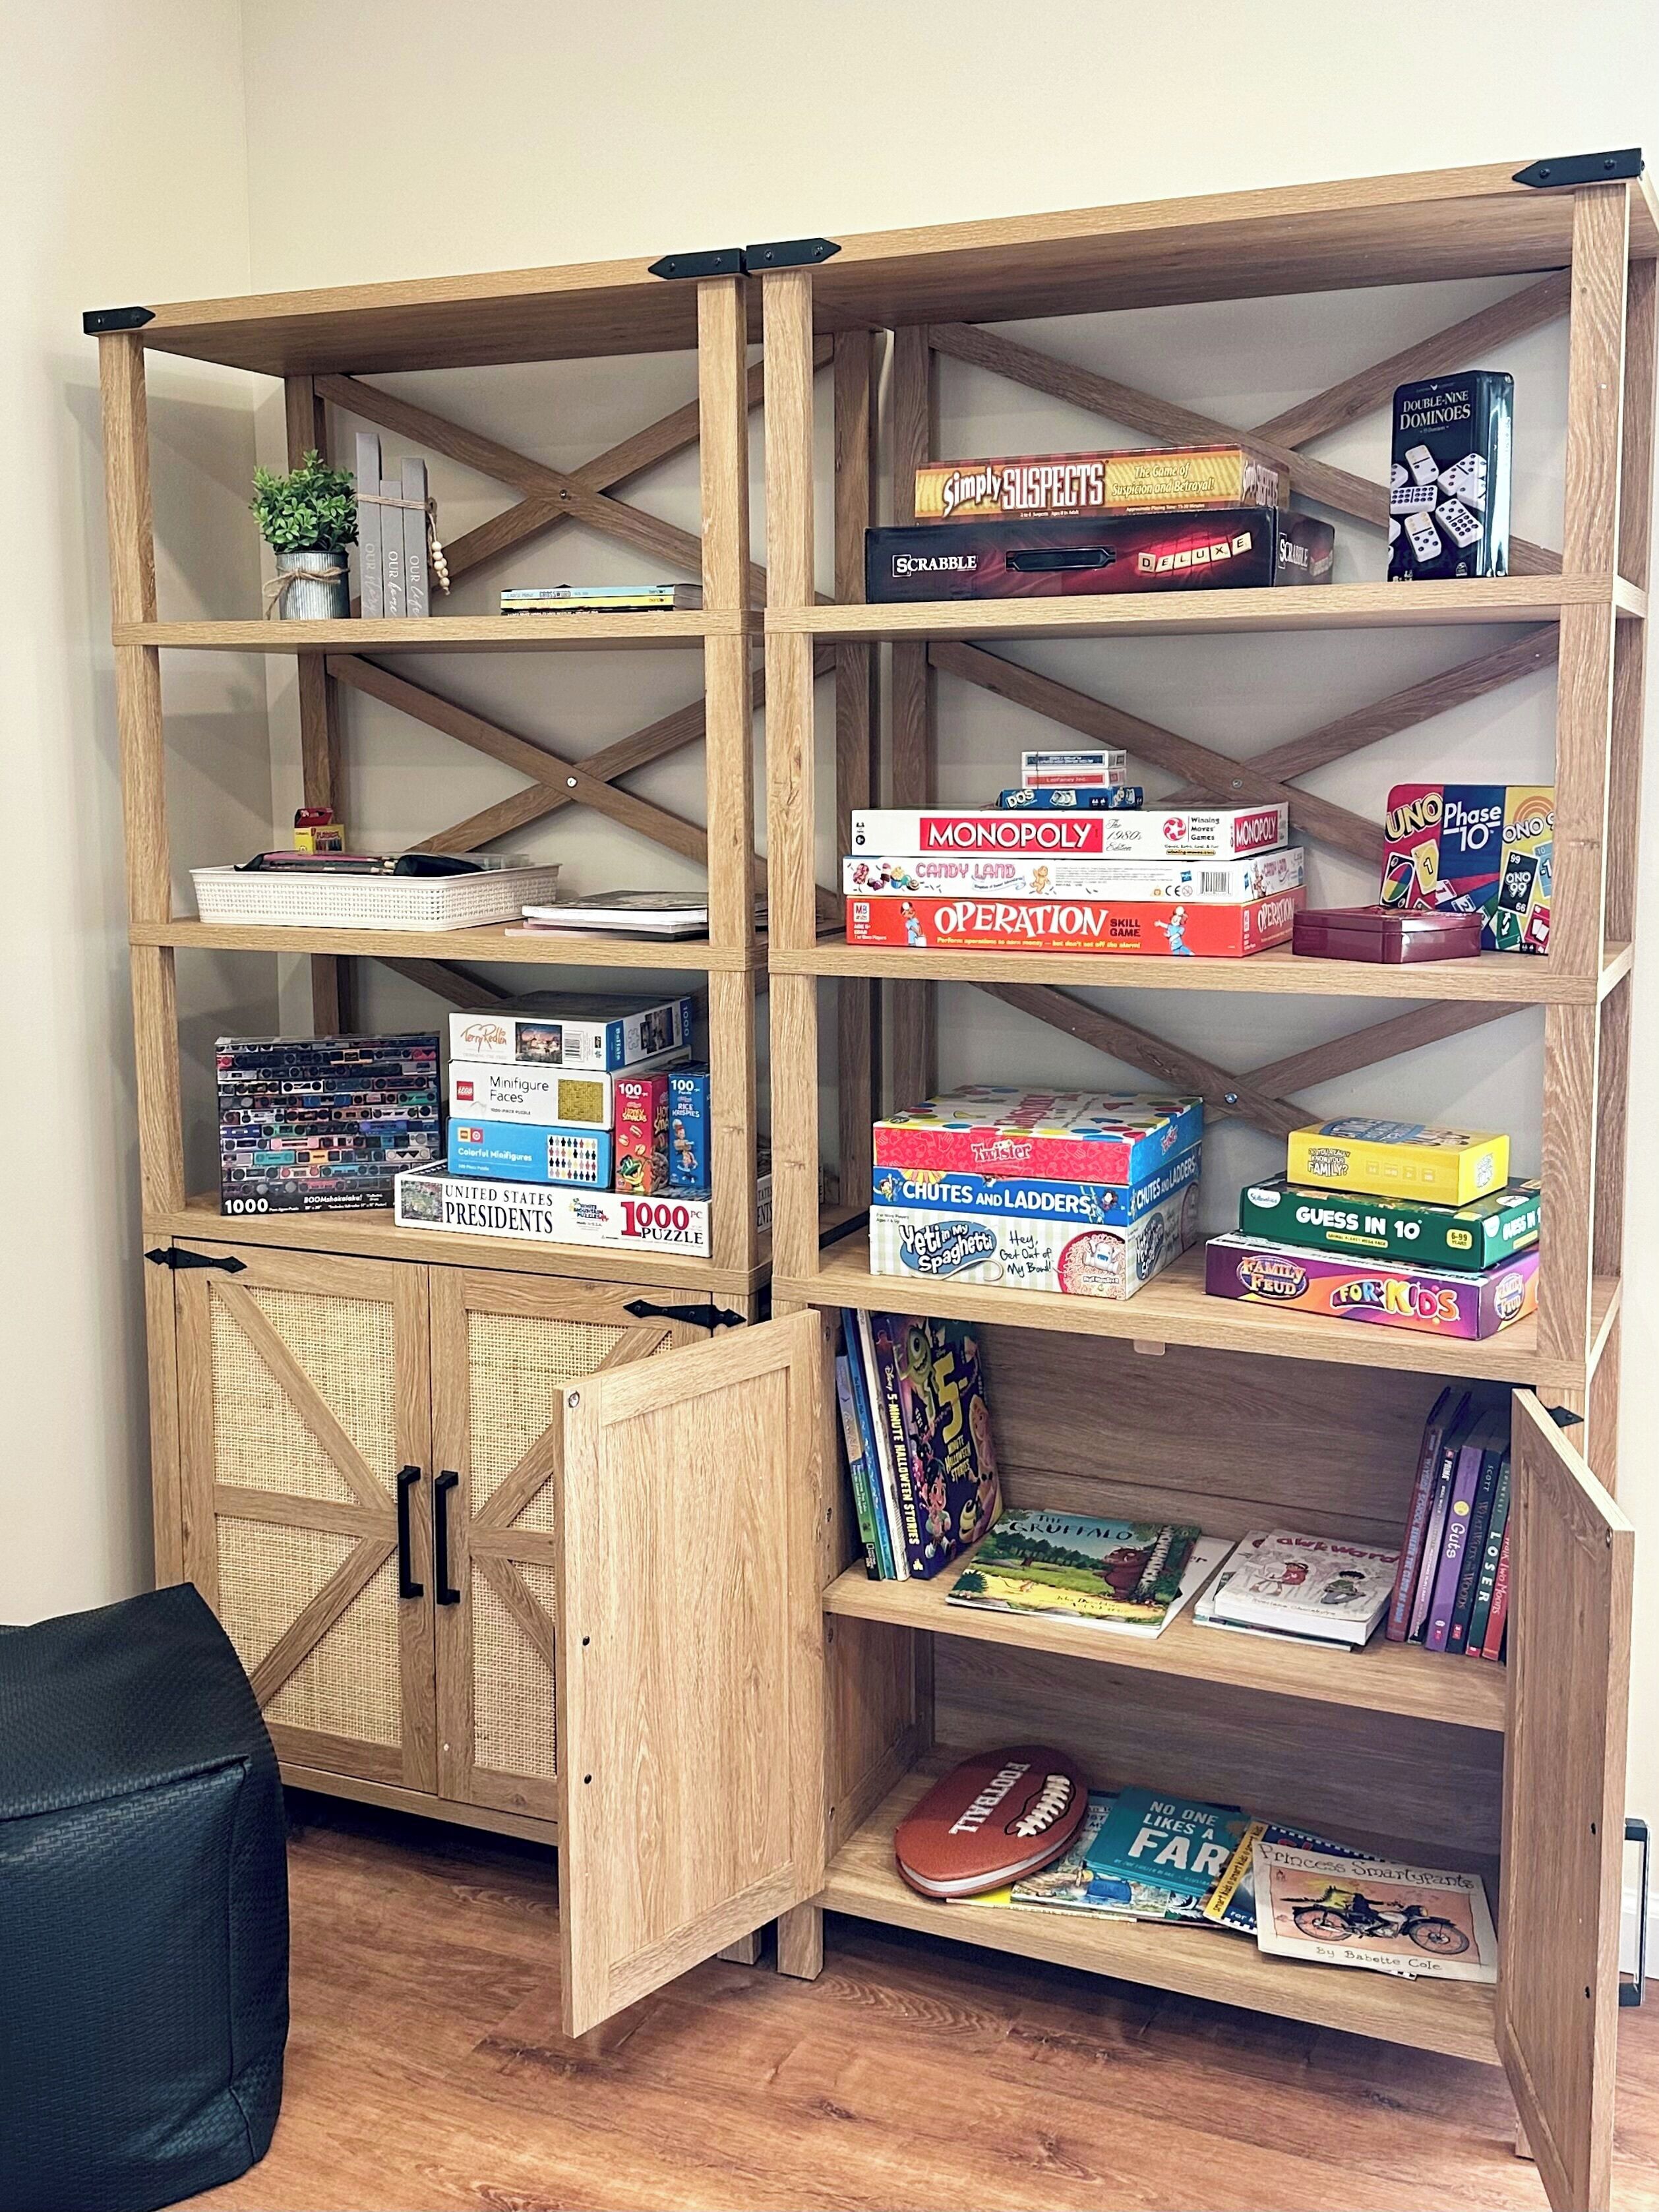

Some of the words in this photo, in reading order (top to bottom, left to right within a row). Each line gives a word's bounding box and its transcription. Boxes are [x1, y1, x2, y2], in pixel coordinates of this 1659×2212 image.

[1403, 390, 1468, 413] DOUBLE-NINE
[1400, 404, 1470, 430] DOMINOES
[1134, 465, 1150, 479] The
[1152, 464, 1177, 477] Game
[1179, 462, 1190, 476] of
[1001, 462, 1104, 511] SUSPECTS
[1112, 483, 1152, 498] Suspicion
[1154, 482, 1172, 494] and
[1174, 477, 1214, 493] Betrayal!
[365, 543, 375, 570] OUR
[388, 551, 399, 578] OUR
[409, 555, 420, 582] OUR
[895, 555, 977, 574] SCRABBLE
[1141, 537, 1244, 568] DELUXE
[1006, 789, 1035, 808] DOS
[1385, 792, 1443, 843] UNO
[1444, 801, 1502, 828] Phase
[927, 822, 1093, 849] MONOPOLY
[1236, 815, 1277, 848] MONOPOLY
[1459, 824, 1489, 851] 10
[1502, 818, 1544, 843] ONO
[915, 862, 969, 879] CANDY
[974, 862, 1016, 880] LAND
[1505, 871, 1531, 884] ONO
[1509, 883, 1528, 898] 99
[934, 901, 1110, 939] OPERATION
[1110, 918, 1141, 928] SKILL
[1257, 897, 1295, 933] OPERATION
[1110, 928, 1141, 938] GAME
[490, 1076, 549, 1093] Minifigure
[490, 1090, 524, 1102] Faces
[458, 1147, 489, 1157] Colorful
[490, 1150, 533, 1162] Minifigures
[971, 1139, 1033, 1162] Twister
[1136, 1177, 1161, 1211] CHUTES
[1170, 1154, 1196, 1189] LADDERS
[1307, 1161, 1348, 1177] FAMILY?
[225, 1199, 268, 1214] 1000
[445, 1185, 497, 1201] UNITED
[504, 1189, 553, 1207] STATES
[901, 1182, 973, 1204] CHUTES
[977, 1191, 1003, 1206] AND
[1004, 1189, 1091, 1214] LADDERS
[445, 1201, 553, 1234] PRESIDENTS
[620, 1201, 690, 1237] 1000
[690, 1211, 703, 1219] PC
[1296, 1206, 1359, 1232] GUESS
[1364, 1216, 1386, 1236] IN
[1393, 1220, 1420, 1240] 10
[1503, 1218, 1527, 1241] GUESS
[1526, 1210, 1536, 1229] IN
[642, 1227, 704, 1245] PUZZLE
[899, 1224, 942, 1255] Yeti
[942, 1229, 950, 1243] in
[951, 1223, 969, 1236] My
[1010, 1230, 1039, 1249] Hey,
[1451, 1232, 1468, 1241] 6-99
[918, 1231, 994, 1274] Spaghetti
[1000, 1248, 1021, 1261] Get
[1022, 1248, 1040, 1259] Out
[1042, 1247, 1052, 1259] of
[1007, 1262, 1026, 1278] My
[1027, 1261, 1051, 1273] Bowl!
[1242, 1257, 1306, 1284] FAMILY
[1250, 1273, 1297, 1296] FEUD
[1339, 1281, 1379, 1303] FOR
[885, 1363, 894, 1392] Disney
[887, 1393, 904, 1441] 5-MINUTE
[894, 1444, 913, 1501] HALLOWEEN
[1483, 1465, 1494, 1492] SCOTT
[903, 1504, 920, 1545] STORIES
[1039, 1514, 1062, 1524] THE
[1475, 1501, 1488, 1529] WHAT
[1009, 1522, 1133, 1541] GRUFFALO
[1446, 1522, 1466, 1559] Guts
[1478, 1531, 1501, 1602] LOSER
[1498, 1563, 1509, 1582] Two
[1458, 1572, 1474, 1609] WOODS
[1492, 1585, 1508, 1615] Moons
[948, 1761, 1030, 1836] FOOTBALL
[1143, 1813, 1196, 1835] LIKES
[1201, 1828, 1215, 1840] A
[1149, 1801, 1176, 1816] NO
[1181, 1808, 1219, 1827] ONE
[1128, 1826, 1230, 1876] FAR
[1258, 1844, 1346, 1874] Princess
[1351, 1861, 1474, 1890] Smartypants
[1213, 1894, 1225, 1912] smart
[1219, 1884, 1232, 1898] kids
[1230, 1863, 1243, 1882] smart
[1238, 1852, 1248, 1867] kids
[1230, 1911, 1248, 1920] For
[1316, 1946, 1335, 1958] By
[1344, 1950, 1401, 1966] Babette
[1408, 1958, 1443, 1971] Cole
